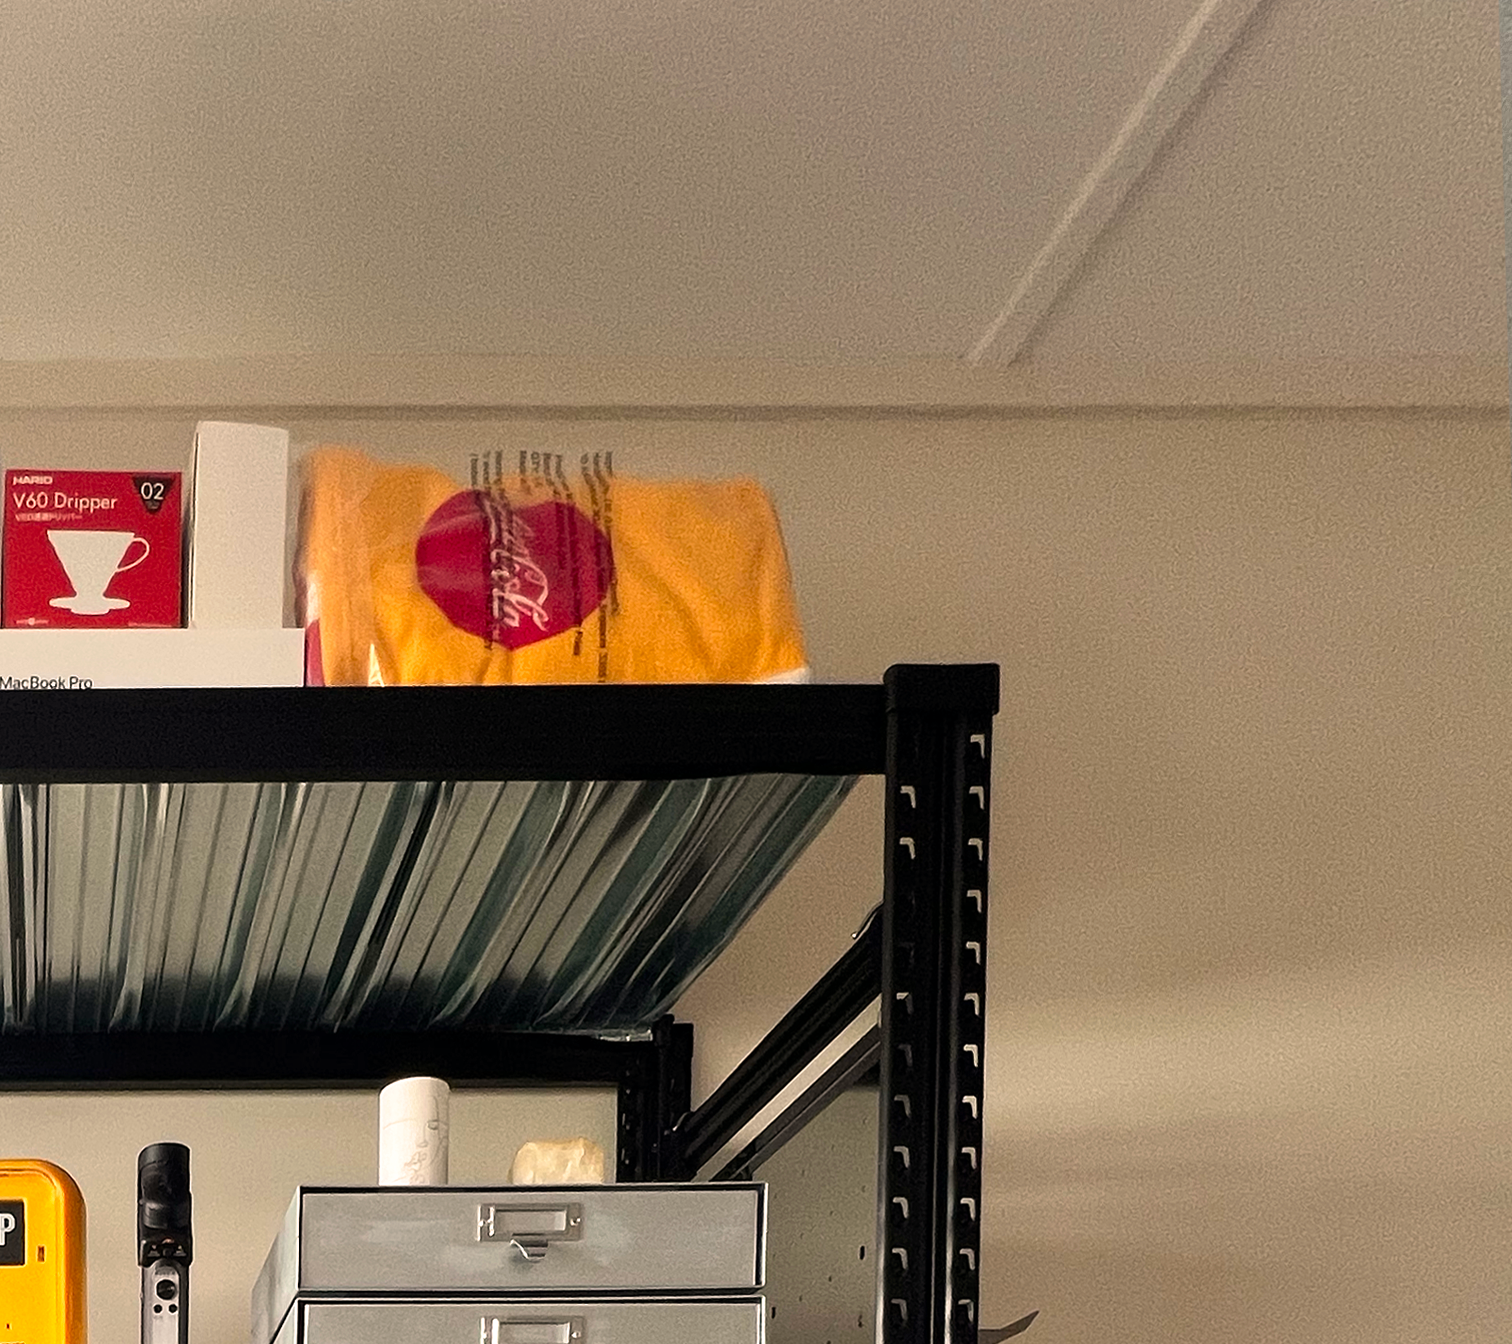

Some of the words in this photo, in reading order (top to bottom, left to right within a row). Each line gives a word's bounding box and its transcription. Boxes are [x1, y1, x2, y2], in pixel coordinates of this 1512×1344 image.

[141, 482, 165, 500] 02
[13, 492, 48, 509] V60
[54, 492, 118, 513] Dripper
[0, 676, 66, 690] MacBook
[69, 676, 93, 690] Pro
